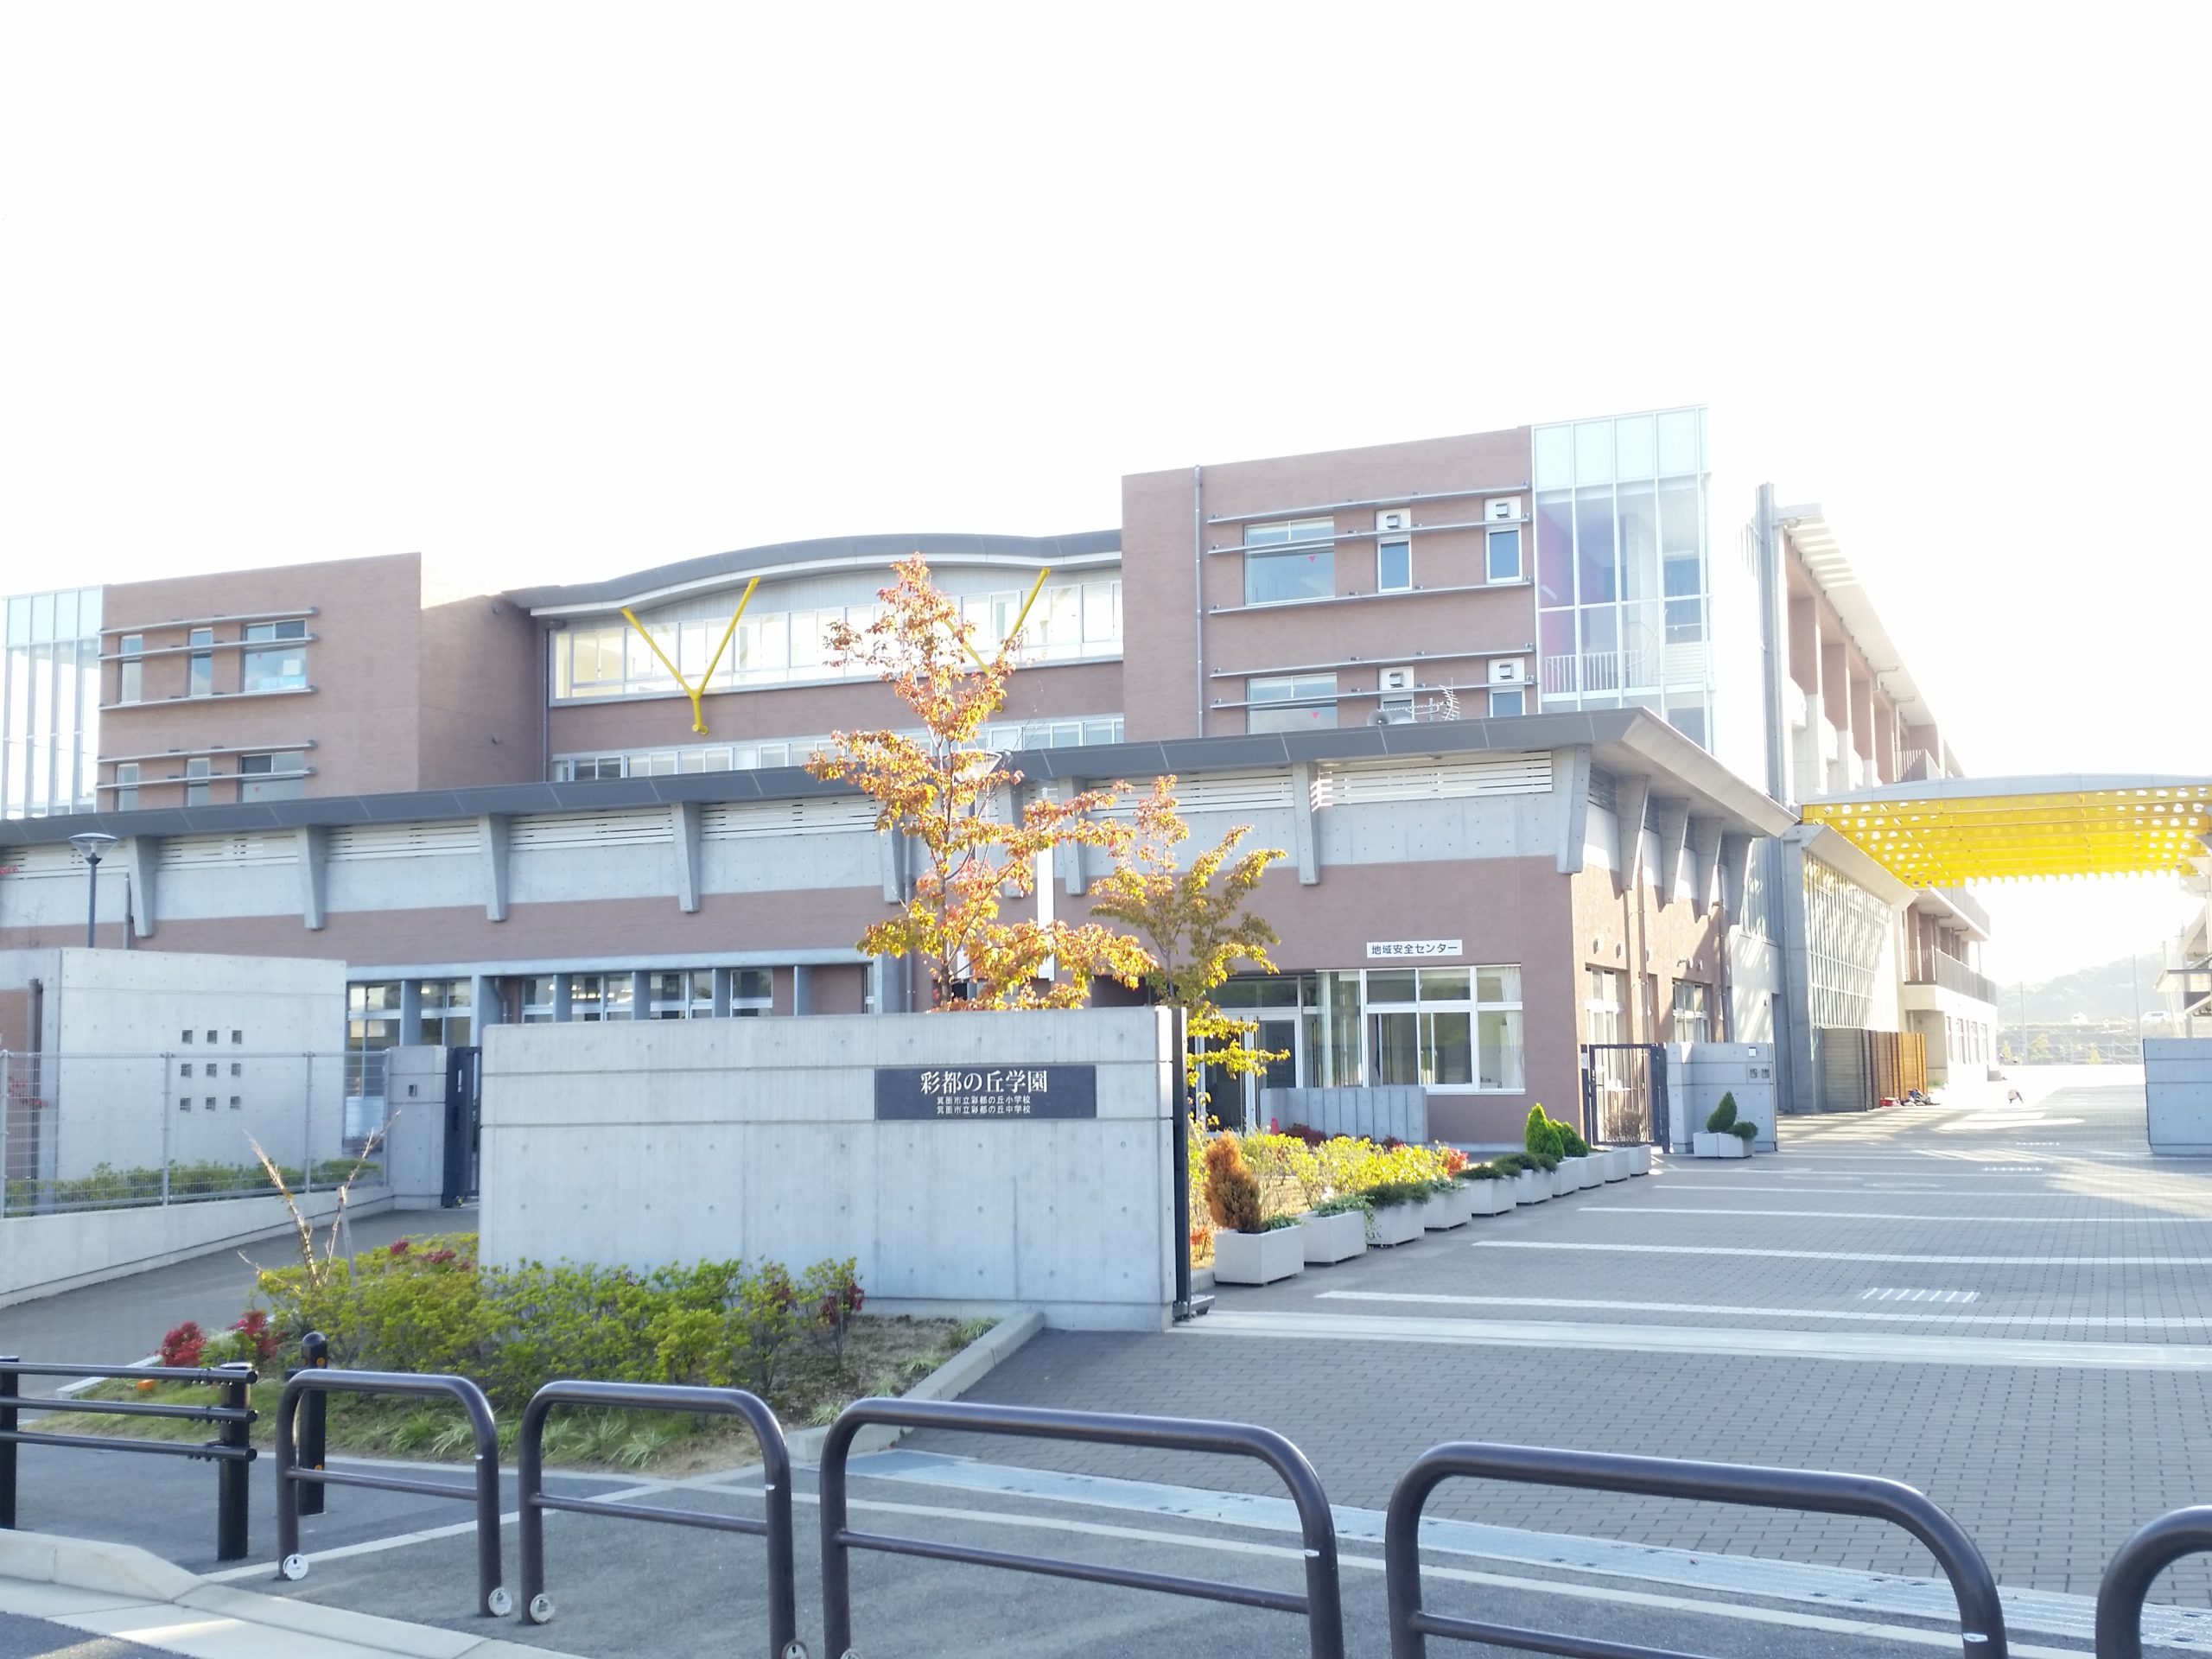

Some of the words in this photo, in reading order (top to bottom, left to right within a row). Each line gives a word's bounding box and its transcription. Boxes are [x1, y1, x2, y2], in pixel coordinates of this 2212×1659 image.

[1371, 943, 1459, 955] 地域安全センター
[920, 1070, 1048, 1095] 彩都の丘学園
[937, 1096, 1031, 1104] 箕面市立彩都の丘小学校
[937, 1104, 1031, 1114] 箕面市立彩都の丘中学校
